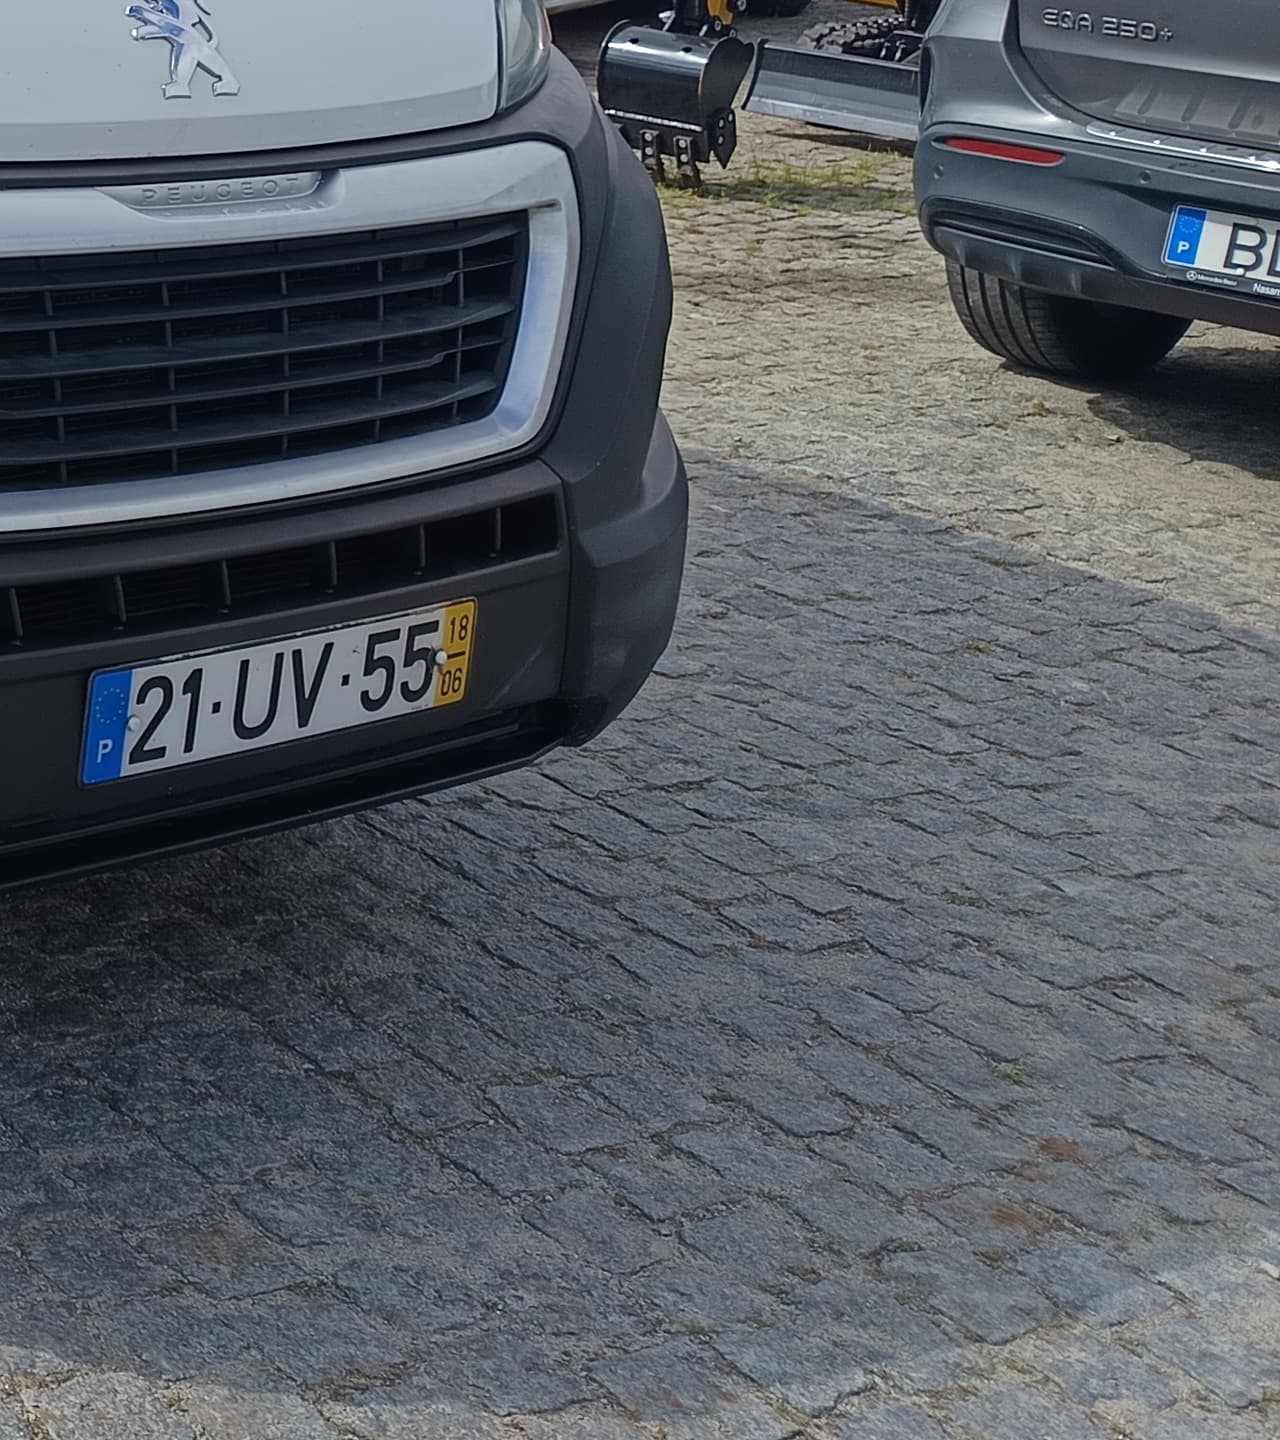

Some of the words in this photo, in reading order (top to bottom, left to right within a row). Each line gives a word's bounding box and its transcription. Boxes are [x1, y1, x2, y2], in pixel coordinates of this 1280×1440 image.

[1041, 8, 1093, 33] EQA
[1101, 16, 1174, 42] 250+
[141, 176, 300, 204] PEUGEOT
[1176, 241, 1191, 255] P
[450, 613, 470, 645] 18
[440, 666, 464, 698] 06
[96, 738, 114, 764] P
